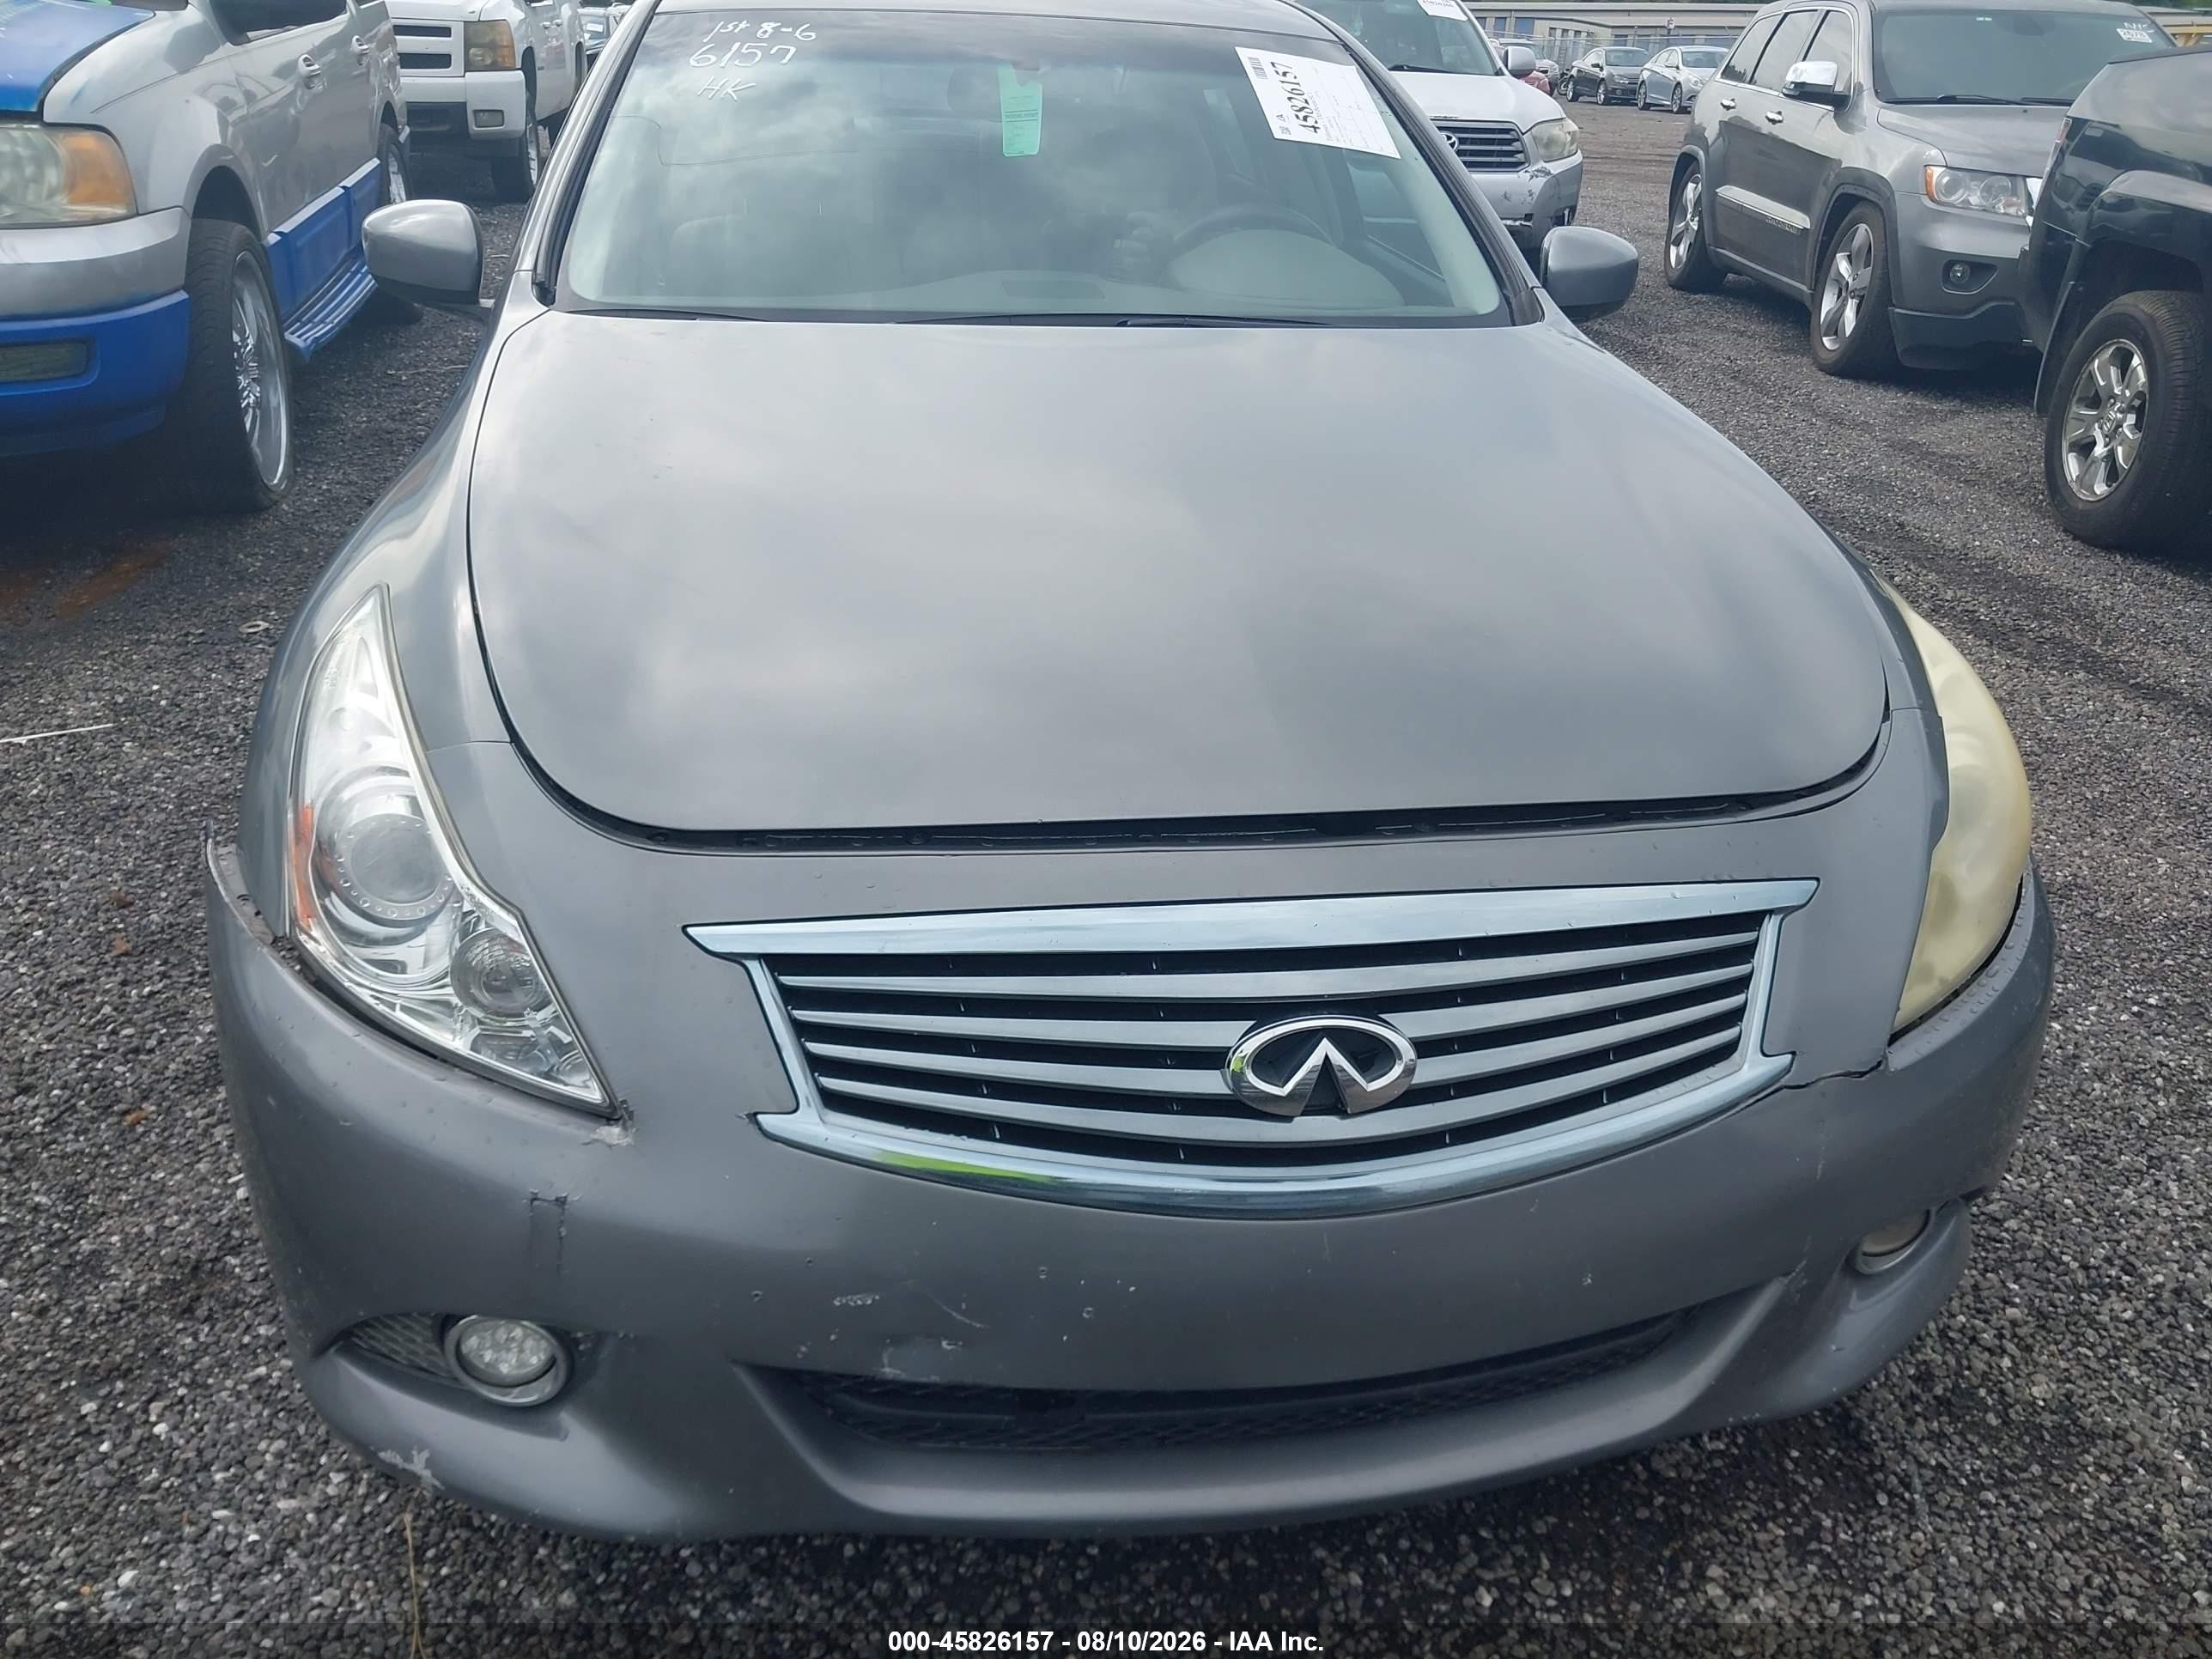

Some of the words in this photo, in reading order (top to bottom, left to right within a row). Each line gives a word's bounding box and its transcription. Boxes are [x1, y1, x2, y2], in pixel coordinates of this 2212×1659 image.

[702, 20, 750, 43] 1st
[756, 21, 817, 41] 8-6
[689, 42, 797, 68] 6157
[696, 76, 757, 101] HK
[1270, 61, 1321, 134] 45826157
